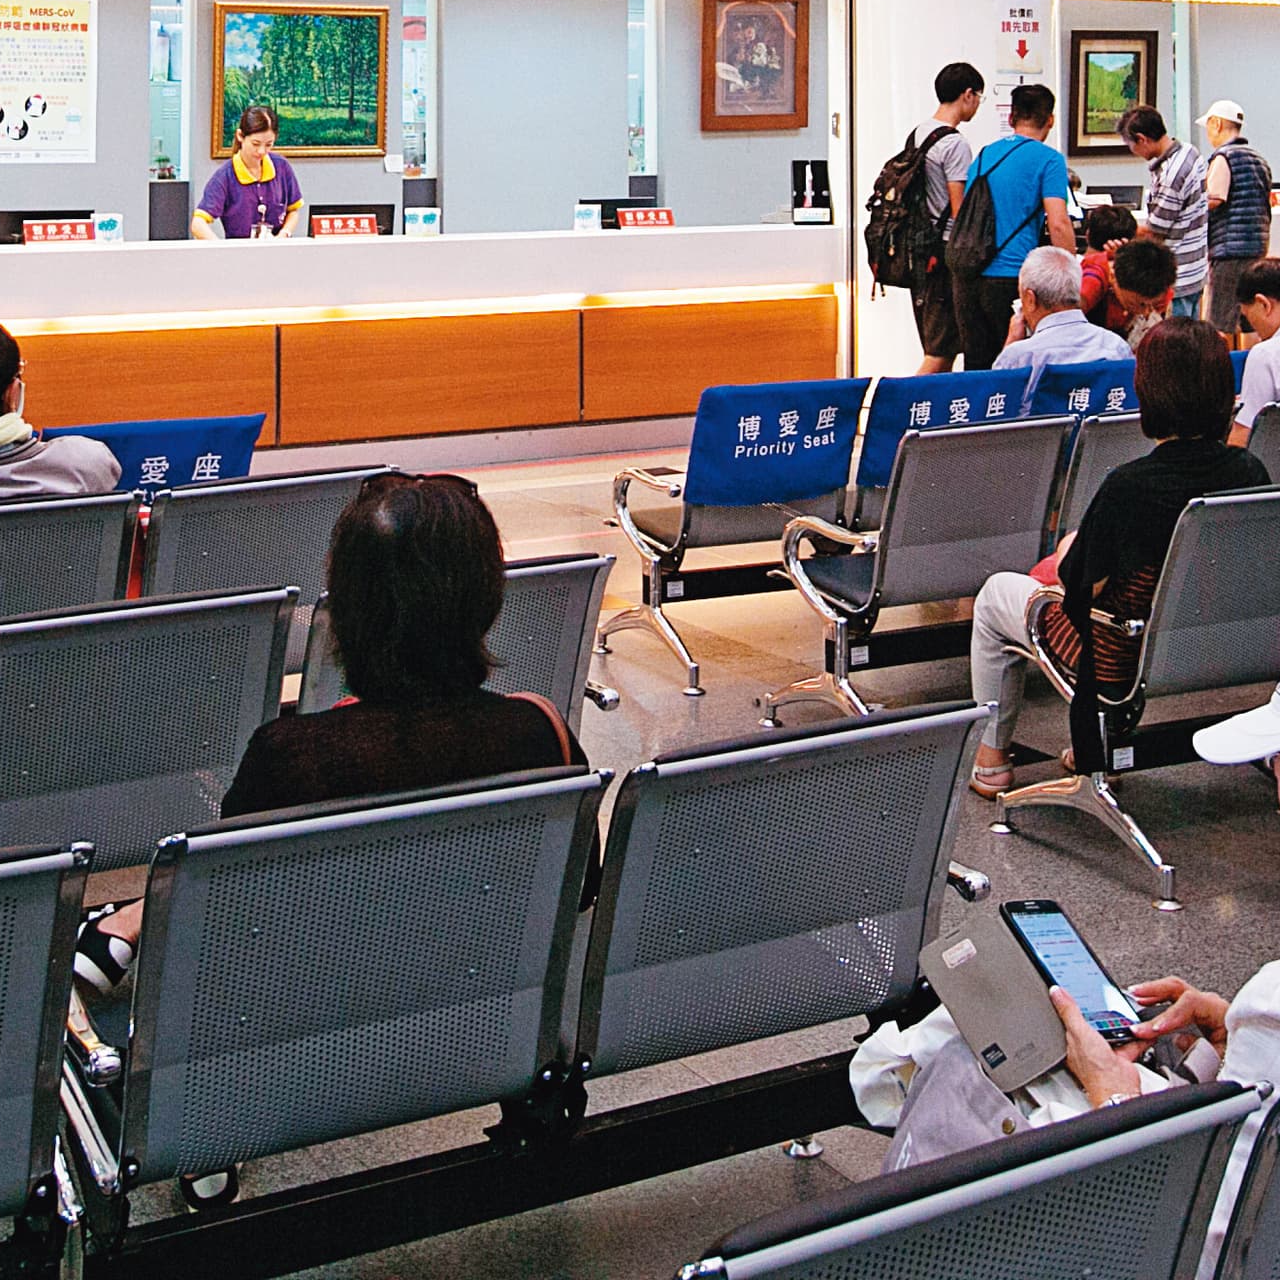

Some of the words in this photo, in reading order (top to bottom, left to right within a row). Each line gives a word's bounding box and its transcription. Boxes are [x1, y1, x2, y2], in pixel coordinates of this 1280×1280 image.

[29, 7, 76, 18] MERS-CoV
[908, 392, 1007, 427] 博愛座
[1067, 387, 1126, 412] 博愛
[737, 406, 839, 442] 博愛座
[734, 441, 796, 458] Priority
[803, 431, 836, 449] Seat
[138, 453, 222, 484] 愛座
